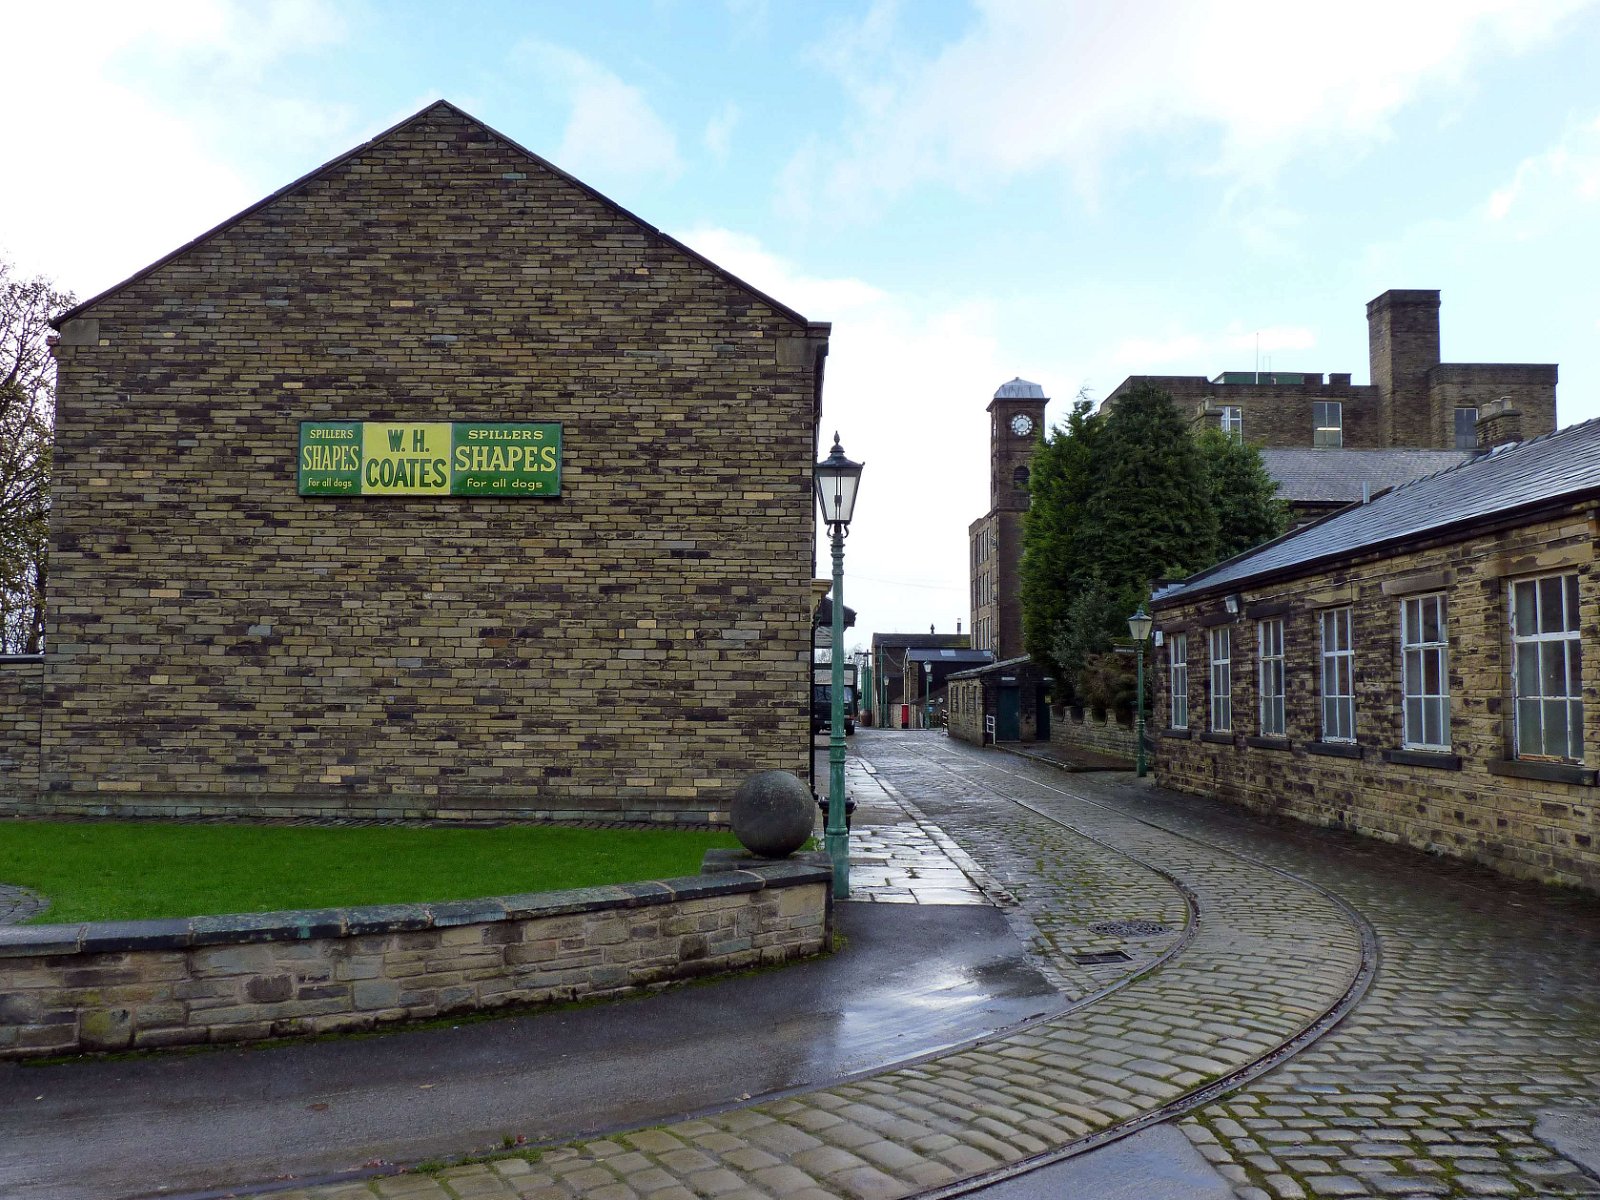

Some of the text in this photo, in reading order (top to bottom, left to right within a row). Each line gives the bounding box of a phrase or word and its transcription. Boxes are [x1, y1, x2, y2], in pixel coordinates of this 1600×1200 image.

[310, 429, 354, 439] SPILLERS
[468, 430, 544, 440] SPILLERS
[302, 445, 360, 471] SHAPES
[455, 446, 557, 472] SHAPES
[365, 458, 447, 488] COATES
[308, 478, 352, 489] for all dogs
[467, 478, 543, 491] for all dogs
